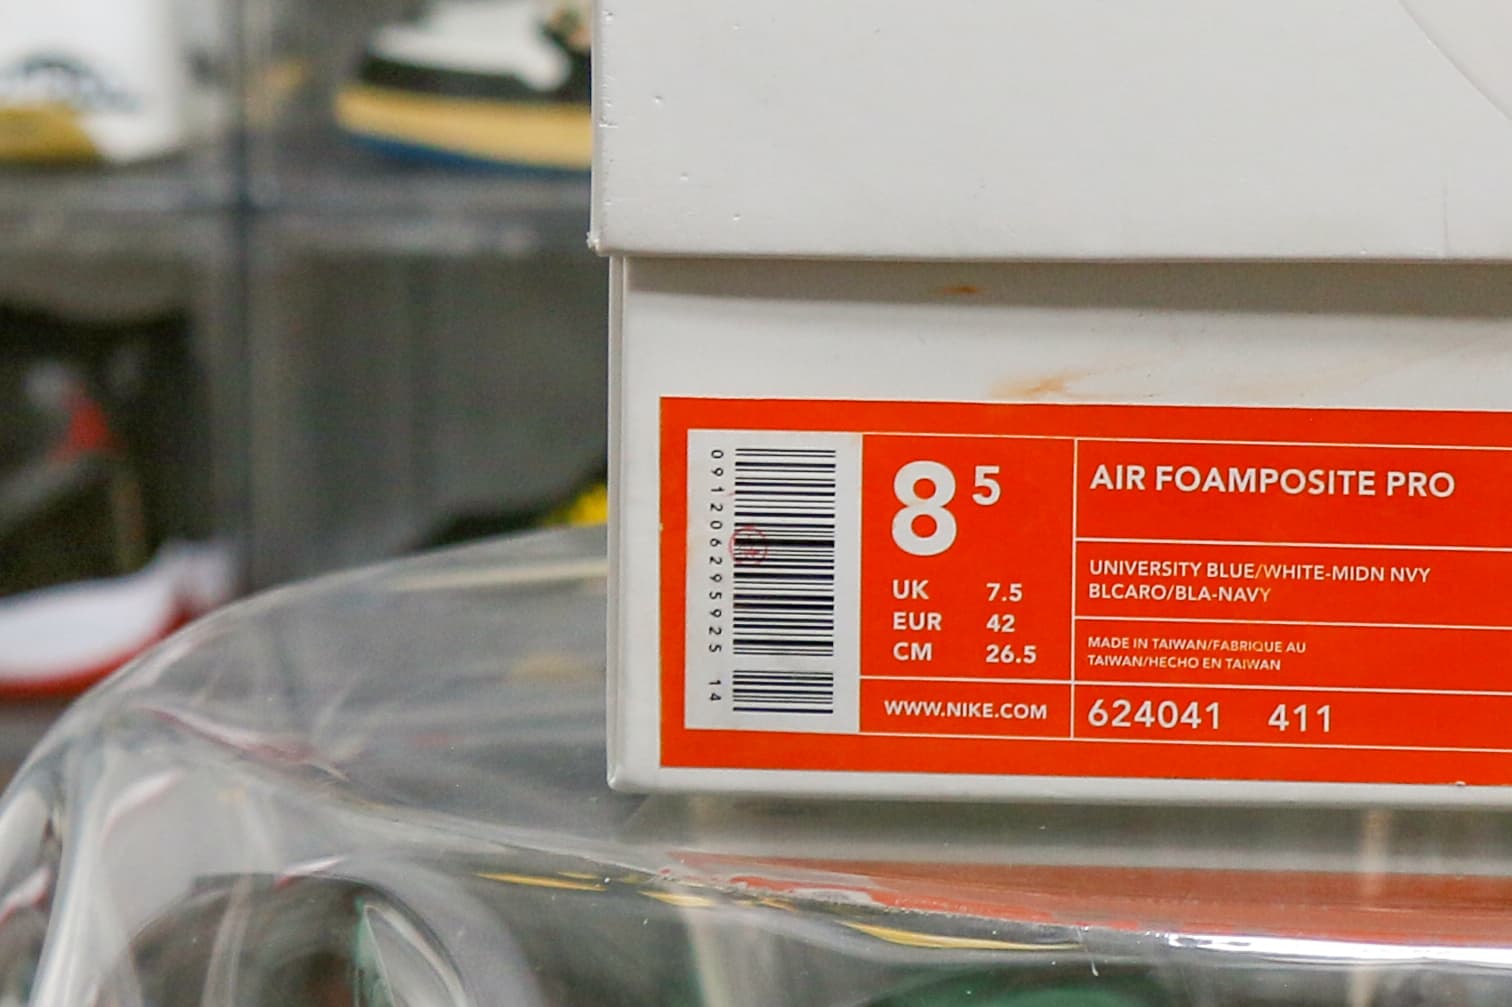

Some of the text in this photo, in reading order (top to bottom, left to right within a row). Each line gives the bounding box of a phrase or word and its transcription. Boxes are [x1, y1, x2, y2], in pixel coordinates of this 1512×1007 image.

[1089, 464, 1455, 498] AIR FOAMPOSITE PRO
[891, 460, 1001, 557] 8 5
[708, 449, 725, 702] 091206295925 14
[1089, 559, 1431, 583] UNIVERSITY BLUE/WHITE-MIDN NVY
[892, 579, 1023, 602] UK 7.5
[1088, 583, 1272, 603] BLCARO/BLA-NAVY
[892, 611, 1016, 633] EUR 42
[892, 641, 1037, 664] CM 26.5
[1087, 637, 1307, 653] MADE IN TAIWAN/FABRIQUE AU
[1087, 654, 1281, 671] TAIWAN/HECHO EN TAIWAN
[883, 695, 1048, 720] WWW.NIKE.COM
[1087, 698, 1331, 732] 624041 411
